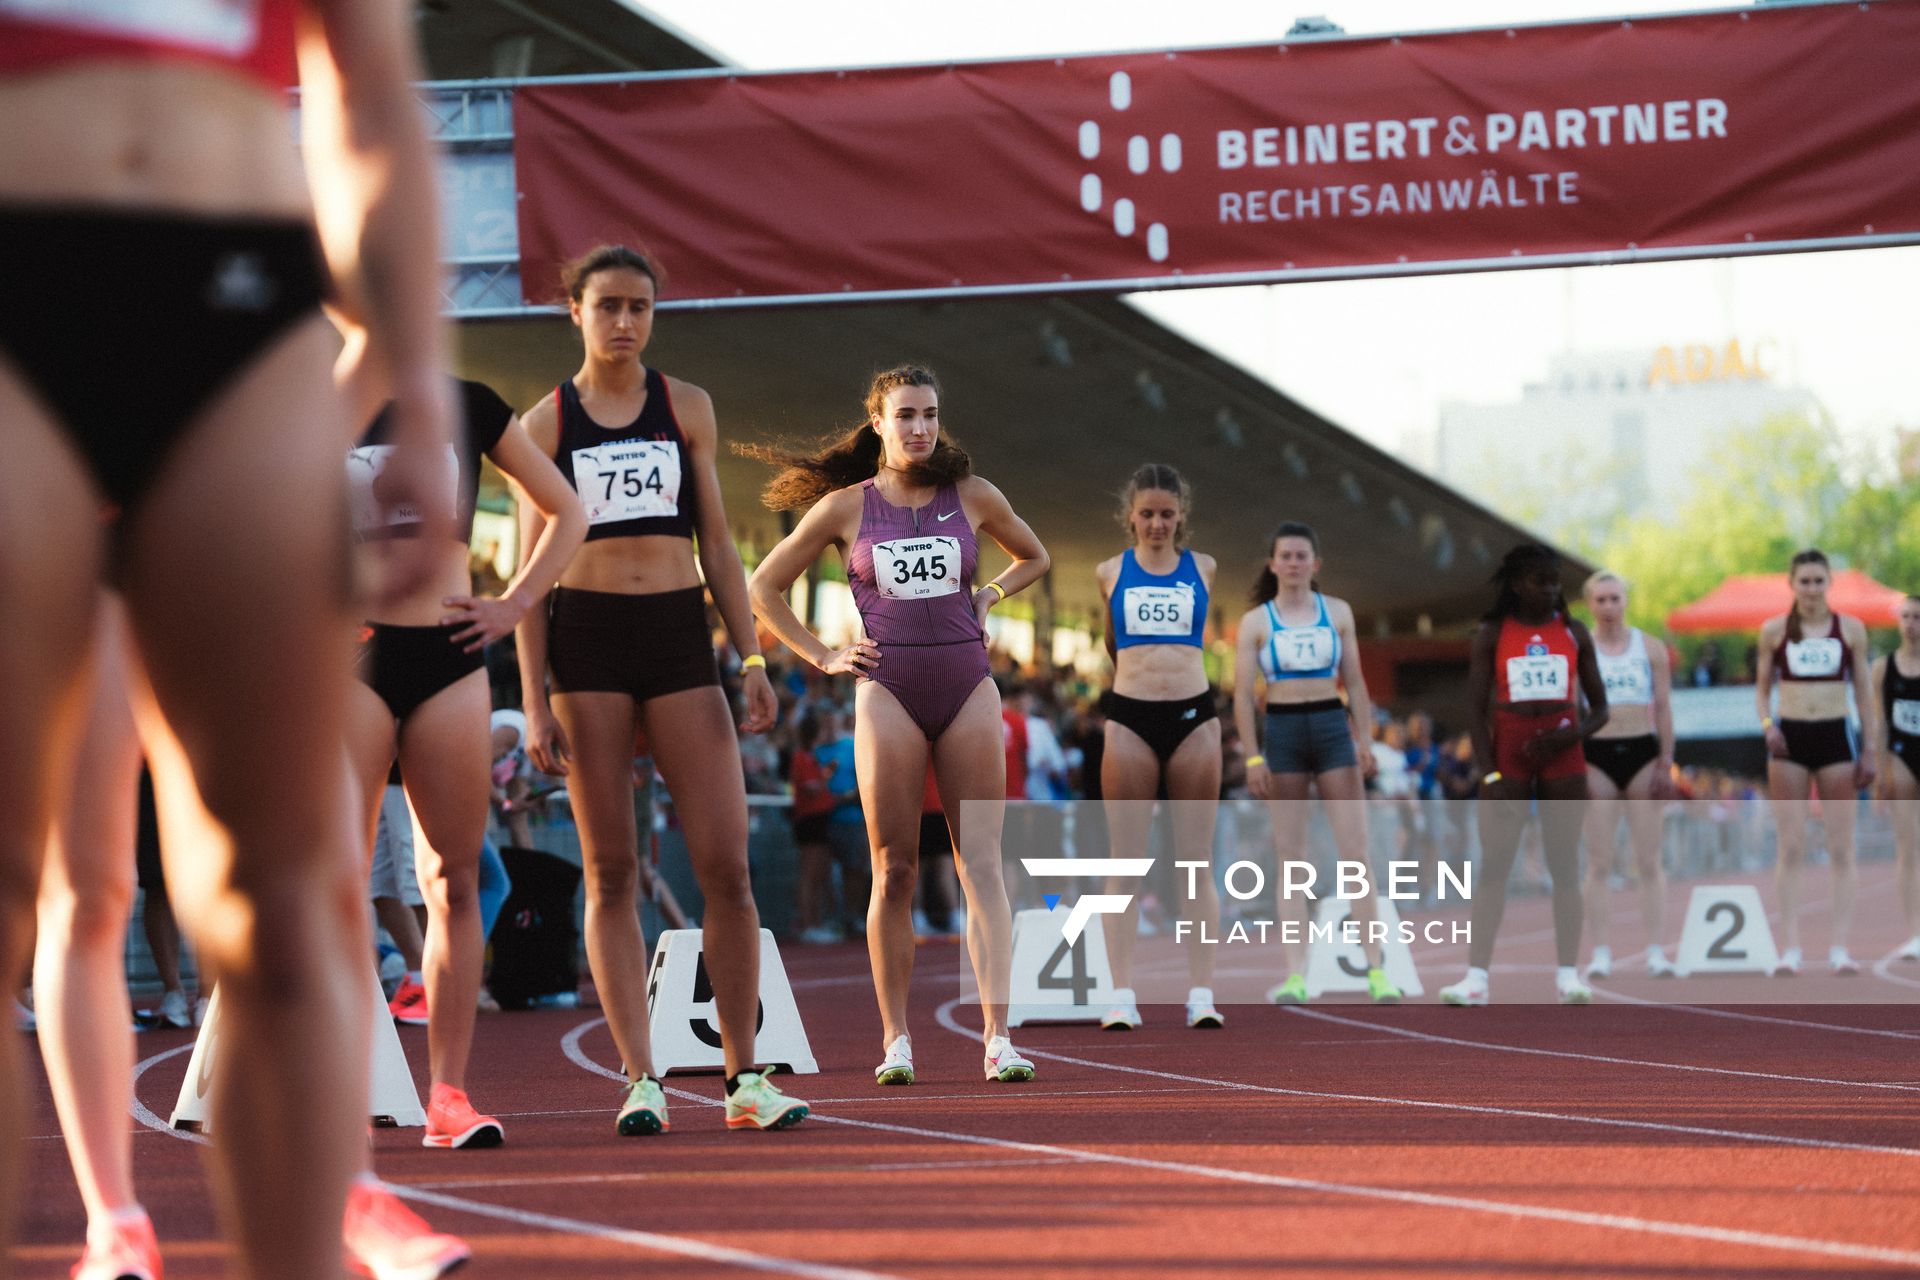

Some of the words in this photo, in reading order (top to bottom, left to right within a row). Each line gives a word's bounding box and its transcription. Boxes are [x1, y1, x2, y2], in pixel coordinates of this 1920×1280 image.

[1218, 169, 1581, 224] RECHTSANWÄLTE
[597, 466, 664, 501] 754
[901, 543, 933, 552] NITRO
[892, 555, 948, 585] 345
[1138, 603, 1180, 623] 655
[1293, 642, 1317, 659] 71
[1522, 670, 1558, 688] 314
[1705, 901, 1748, 960] 2
[1037, 928, 1098, 1006] 4
